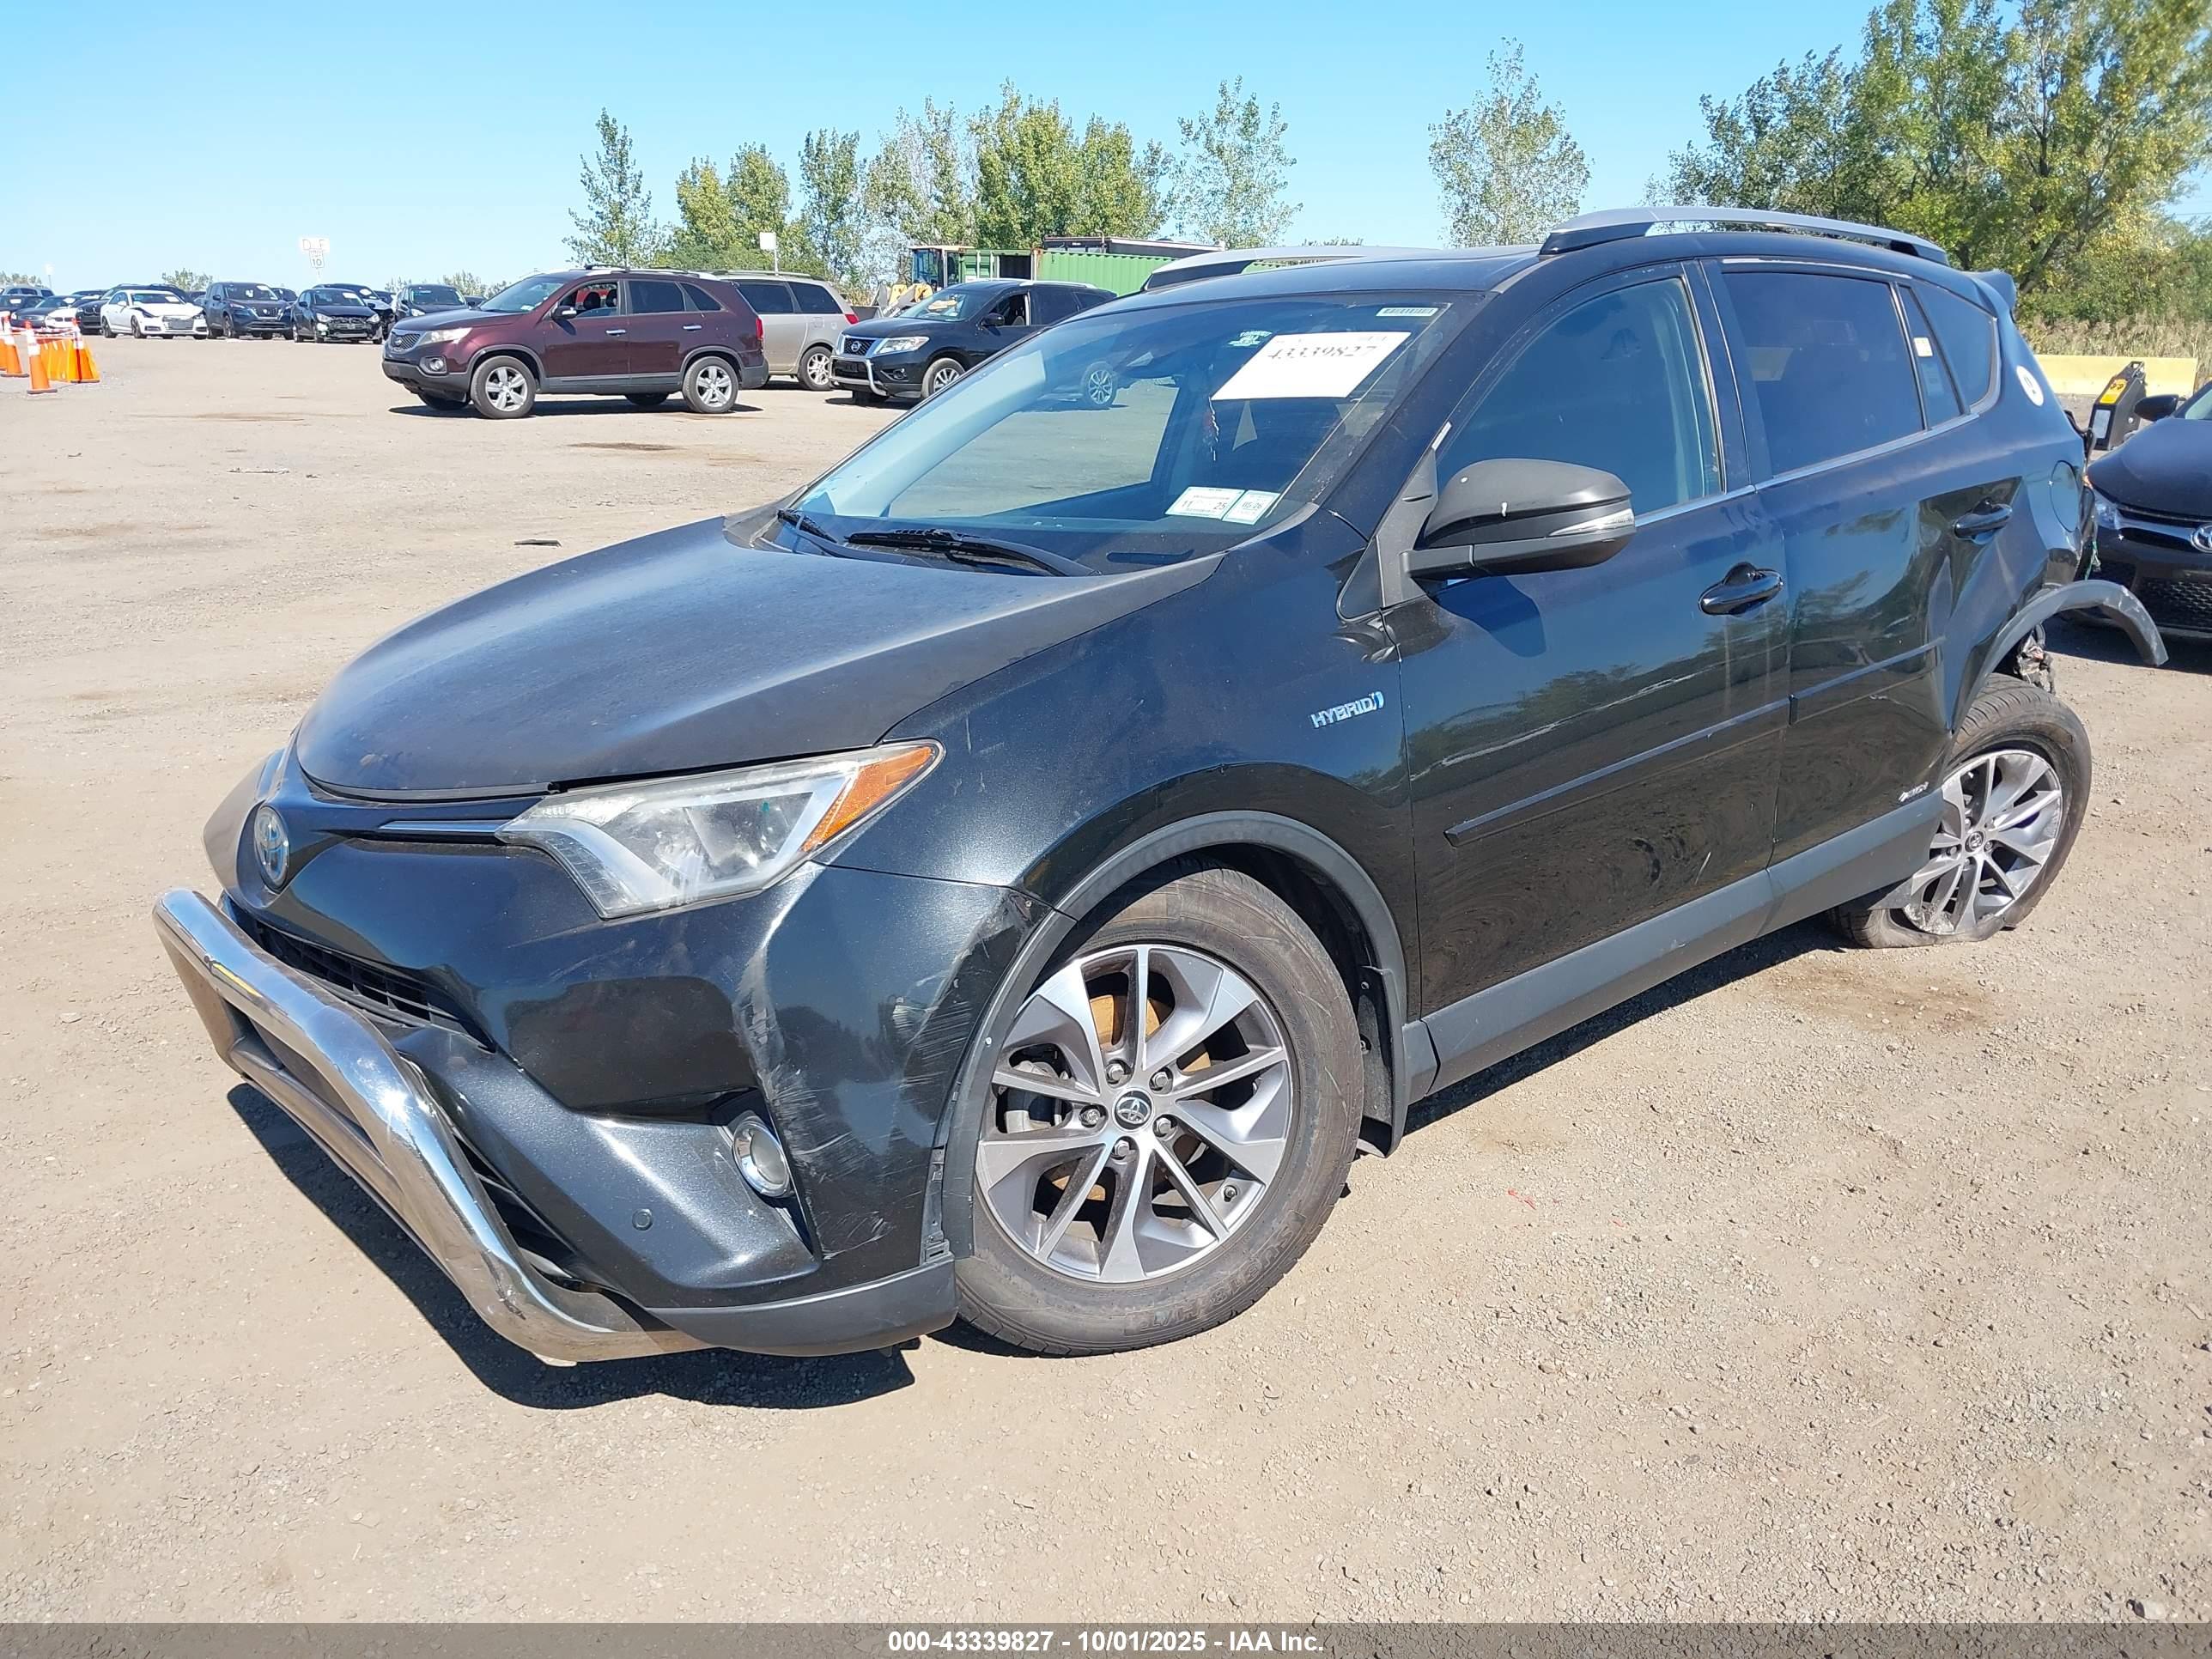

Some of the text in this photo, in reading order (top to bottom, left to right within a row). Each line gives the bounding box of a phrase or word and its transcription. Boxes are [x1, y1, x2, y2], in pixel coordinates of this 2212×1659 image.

[312, 258, 323, 267] 10
[1268, 345, 1378, 360] 43339827
[1310, 696, 1375, 728] HYBRID
